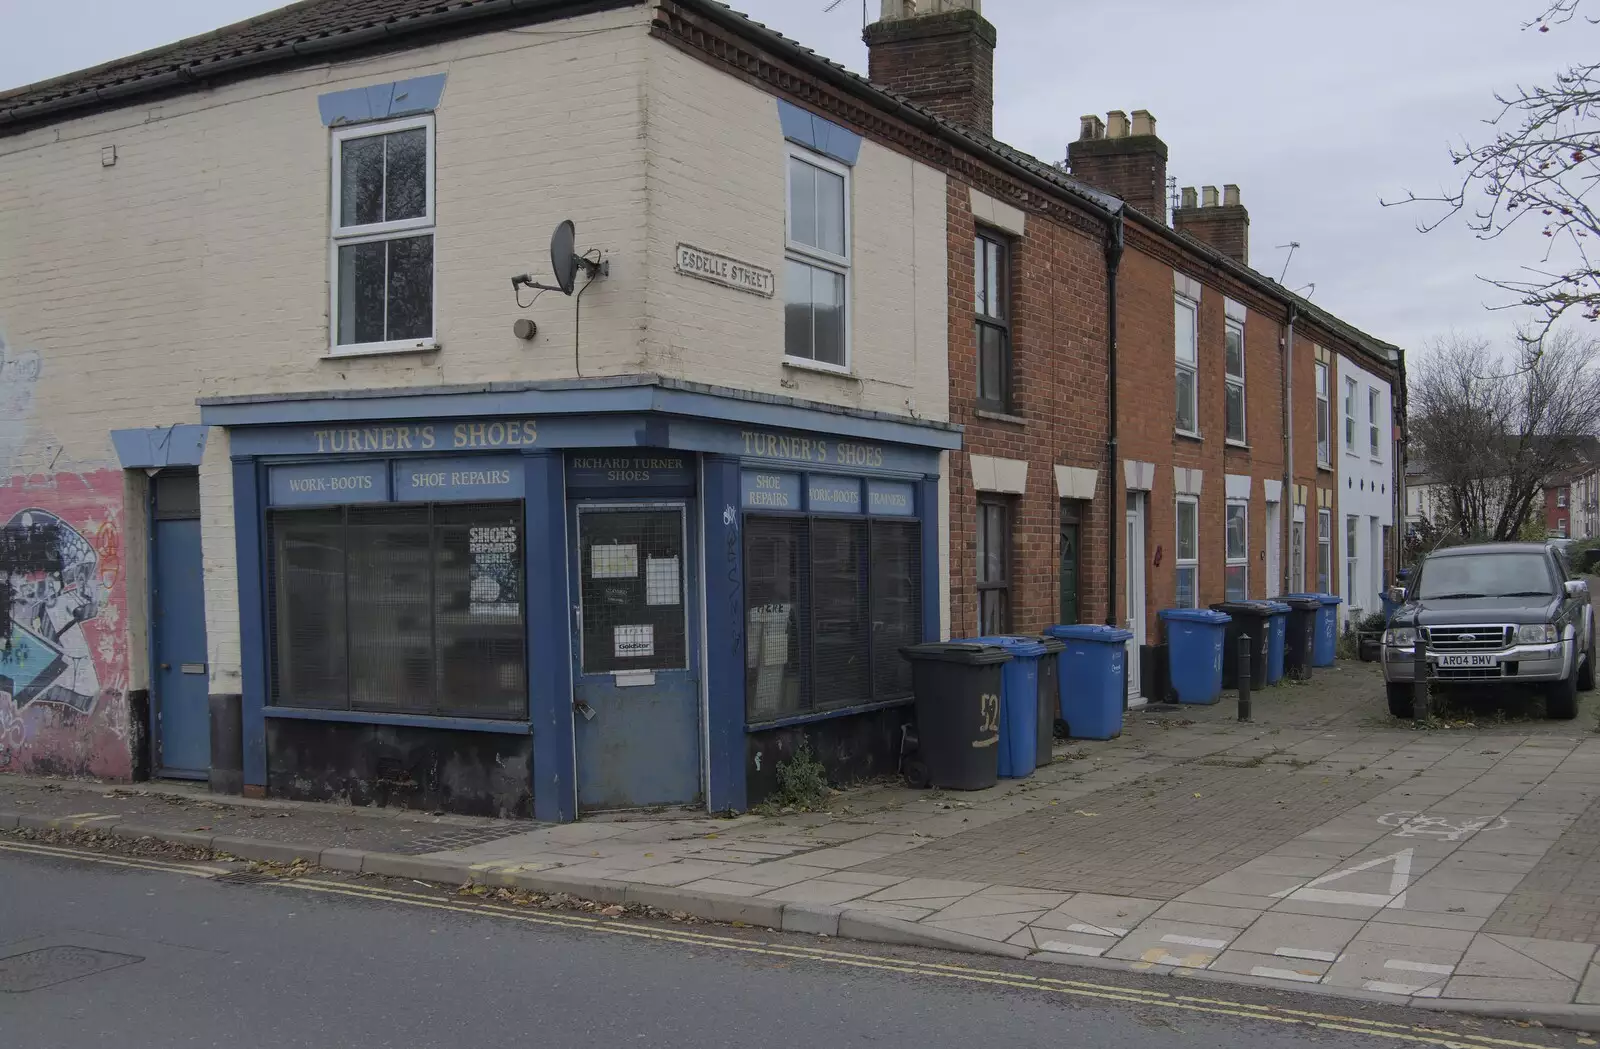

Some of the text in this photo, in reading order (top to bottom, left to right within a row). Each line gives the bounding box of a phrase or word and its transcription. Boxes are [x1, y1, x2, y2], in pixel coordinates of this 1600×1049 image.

[682, 250, 769, 289] ESDELLE STREET
[314, 420, 538, 454] TURNER'S SHOES
[741, 430, 883, 467] TURNER'S SHOES
[573, 457, 684, 469] RICHARD TURNER
[411, 470, 511, 487] SHOE REPAIRS
[607, 470, 650, 481] SHOES
[756, 474, 781, 490] SHOE
[289, 475, 373, 493] WORK-BOOTS
[750, 491, 789, 507] REPAIRS
[869, 492, 906, 507] TRAINERS
[469, 527, 517, 543] SHOES
[469, 542, 517, 554] REPAIRED
[1443, 655, 1491, 665] AR04 BMV
[980, 693, 998, 732] 52
